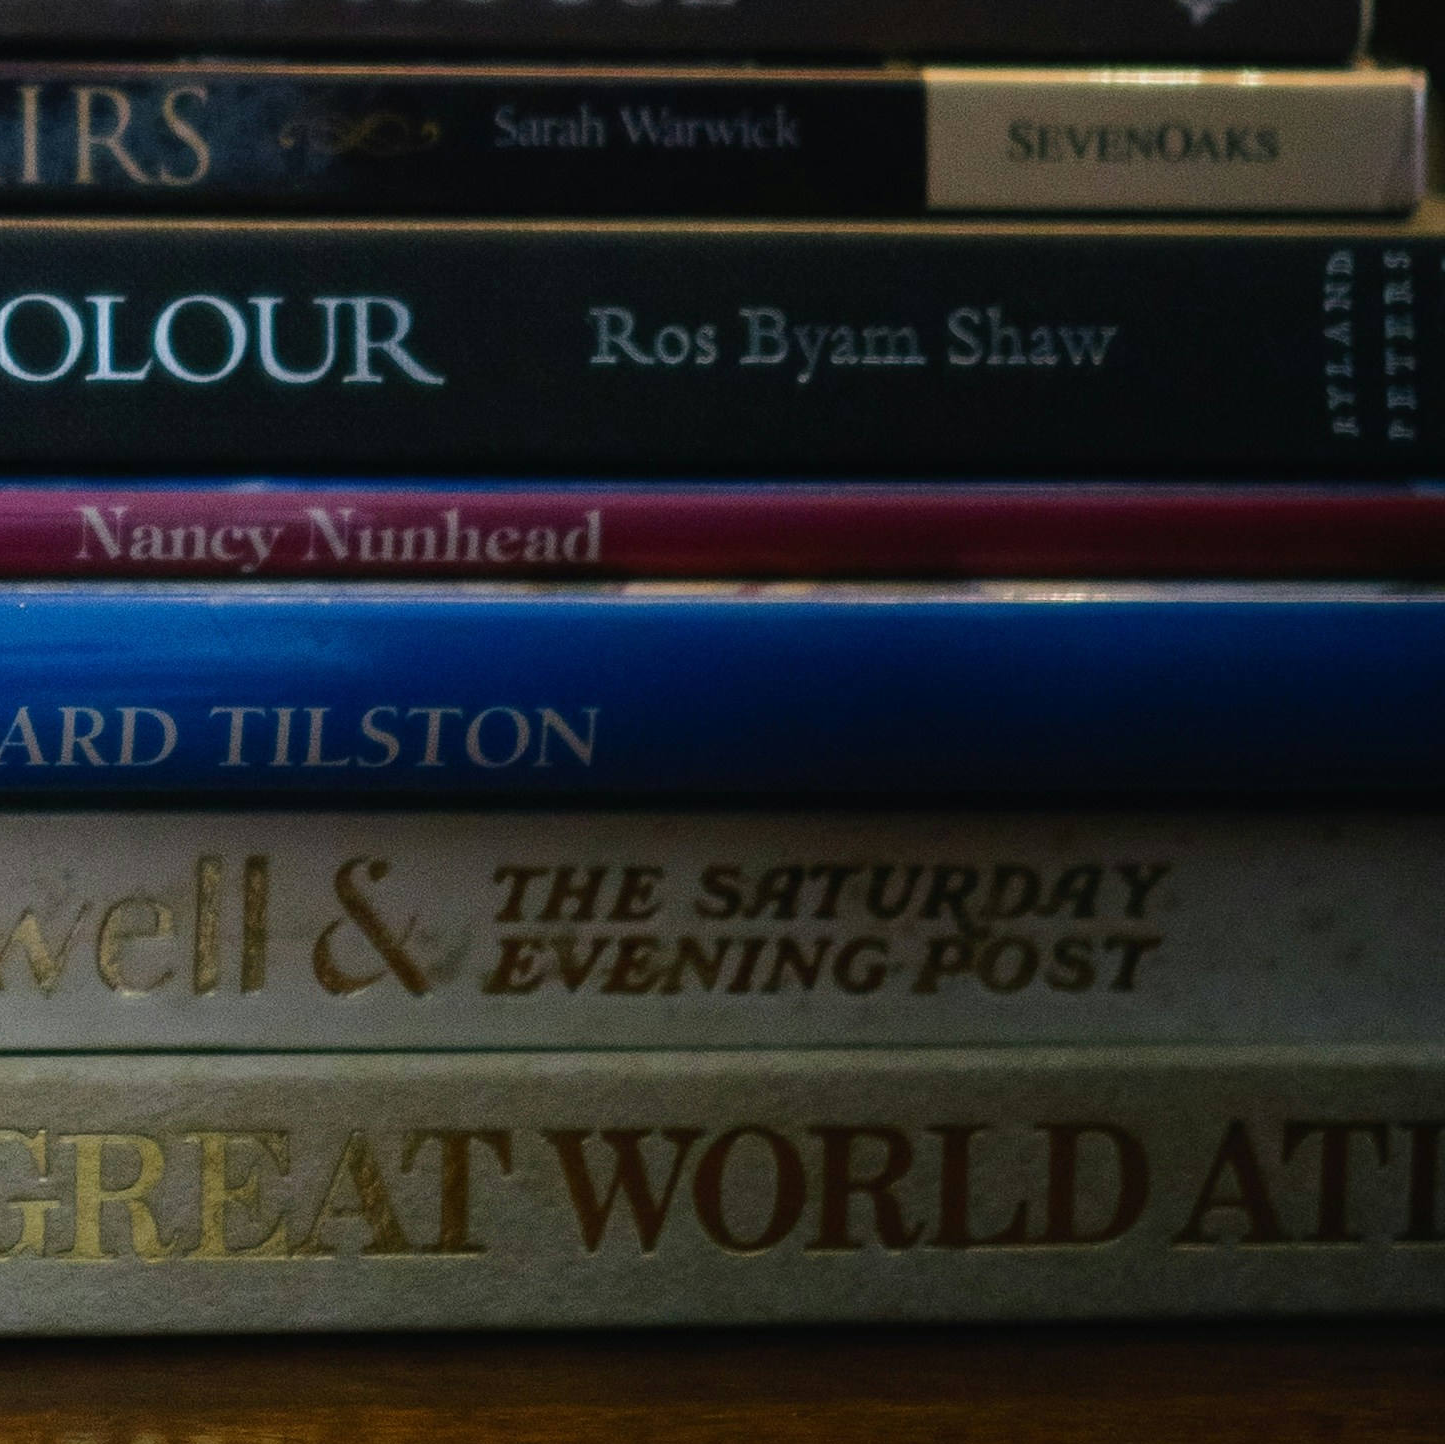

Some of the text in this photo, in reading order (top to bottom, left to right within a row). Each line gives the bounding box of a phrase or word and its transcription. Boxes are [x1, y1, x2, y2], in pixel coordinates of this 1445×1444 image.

[493, 103, 799, 149] Sarah Warwick
[588, 304, 1118, 387] Ros Byam Shaw
[1322, 249, 1360, 438] RYLAND
[1381, 250, 1418, 442] PETERS
[75, 505, 285, 570] Nancy
[303, 508, 602, 568] Nunhead
[209, 706, 600, 769] TILSTON
[313, 856, 471, 996] &
[493, 862, 1172, 934] THE SATURDAY
[481, 936, 1164, 996] EVENING POST
[541, 1122, 1152, 1255] WORLD
